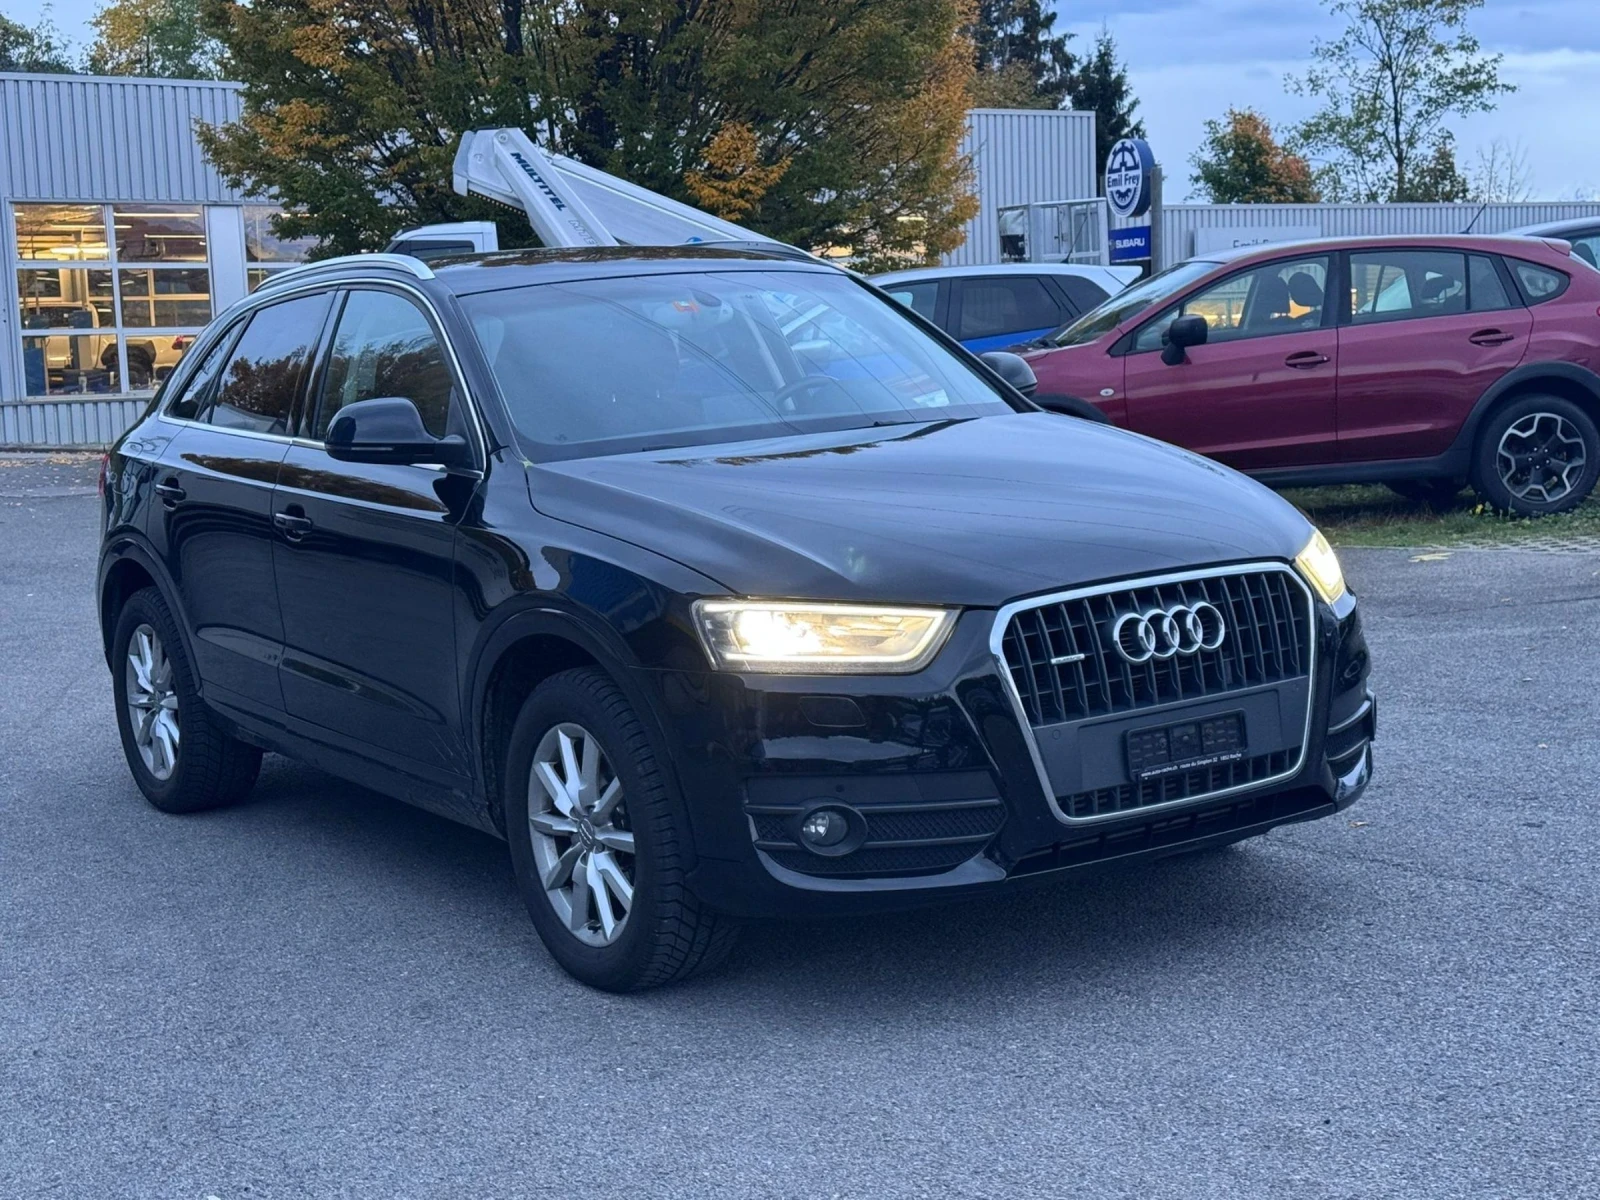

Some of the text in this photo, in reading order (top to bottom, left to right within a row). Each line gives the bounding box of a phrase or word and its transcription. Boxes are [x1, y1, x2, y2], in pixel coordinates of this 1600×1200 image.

[510, 152, 567, 212] MULTITEL
[1107, 173, 1140, 188] Emil Frey
[1115, 237, 1145, 249] SUBARU
